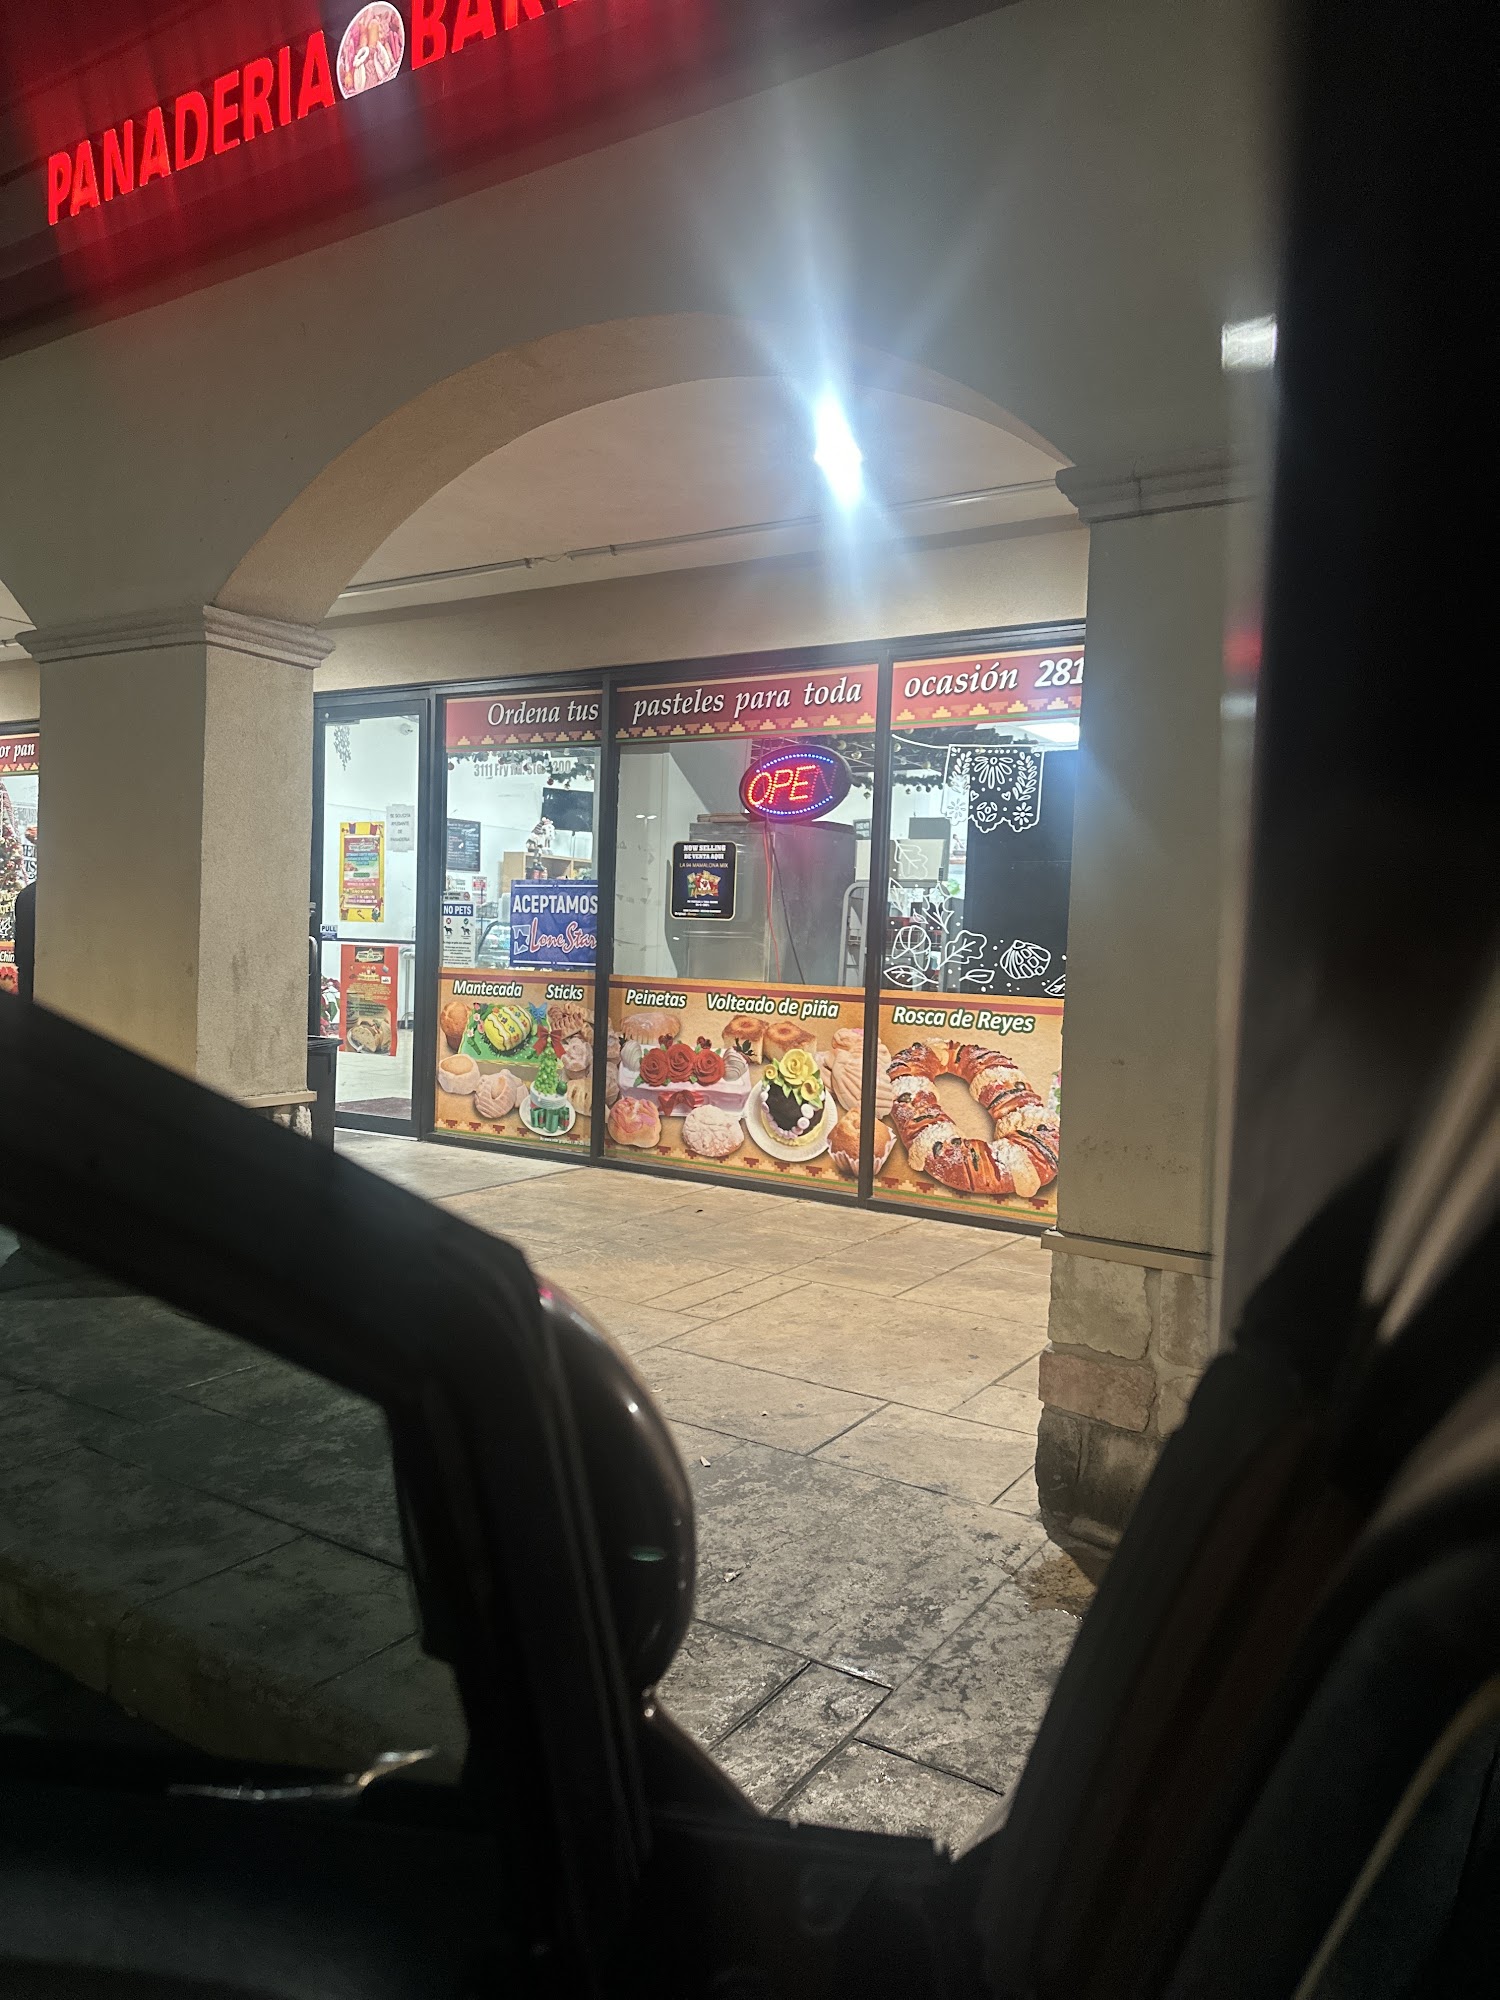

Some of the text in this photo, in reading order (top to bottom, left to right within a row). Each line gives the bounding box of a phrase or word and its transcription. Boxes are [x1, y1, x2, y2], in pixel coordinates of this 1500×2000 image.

[46, 29, 337, 227] PANADERIA
[488, 657, 1085, 728] Ordena tus pasteles para toda ocasión 281
[13, 743, 35, 763] pan
[474, 763, 493, 776] 3111
[494, 762, 508, 777] Fry
[747, 761, 838, 807] OPEN
[443, 905, 472, 915] NO PETS
[513, 894, 598, 915] ACEPTAMOS
[453, 980, 584, 1001] Mantecada Sticks
[625, 988, 840, 1021] Peinetas Volteado de piña
[893, 1006, 1037, 1037] Rosca de Reyes
